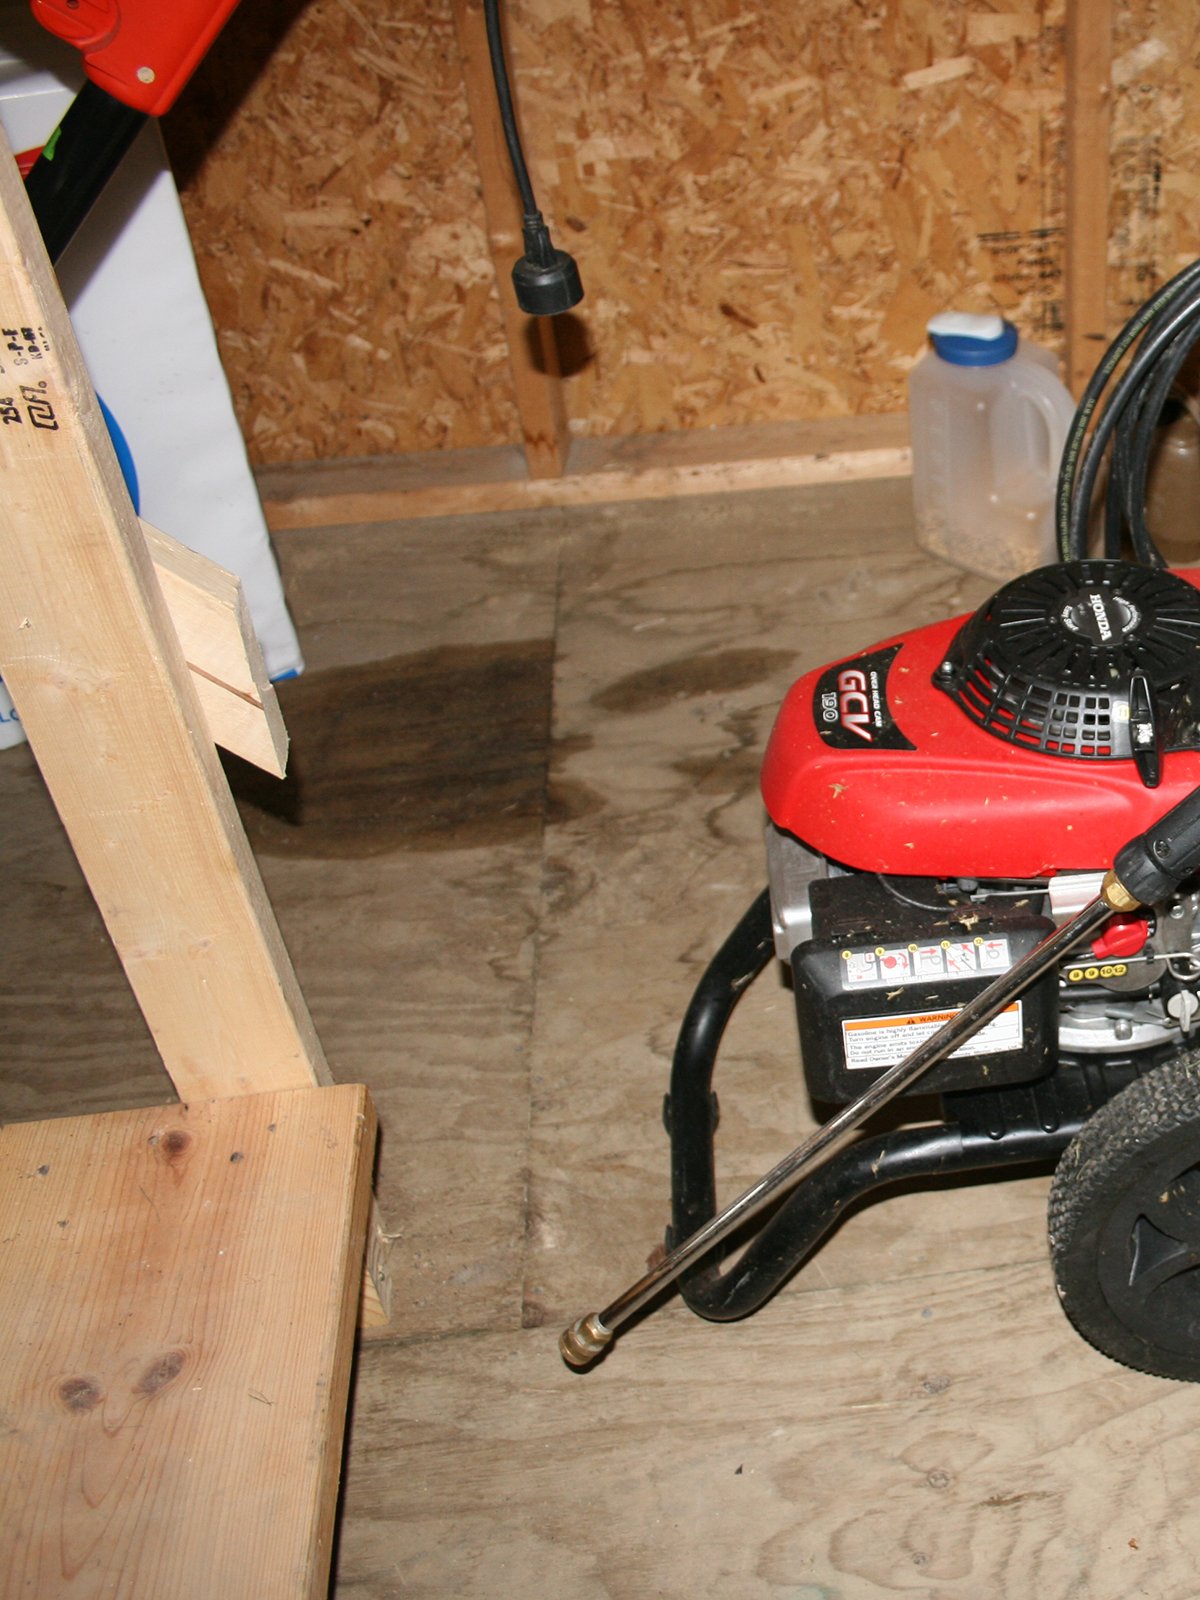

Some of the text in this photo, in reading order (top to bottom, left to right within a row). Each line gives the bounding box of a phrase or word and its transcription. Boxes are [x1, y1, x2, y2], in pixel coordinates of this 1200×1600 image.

[1089, 594, 1113, 641] HONDA
[821, 691, 839, 722] 190
[838, 669, 873, 743] GCV
[870, 671, 883, 728] OVER HEAD CAM
[919, 1012, 955, 1022] WARNIN
